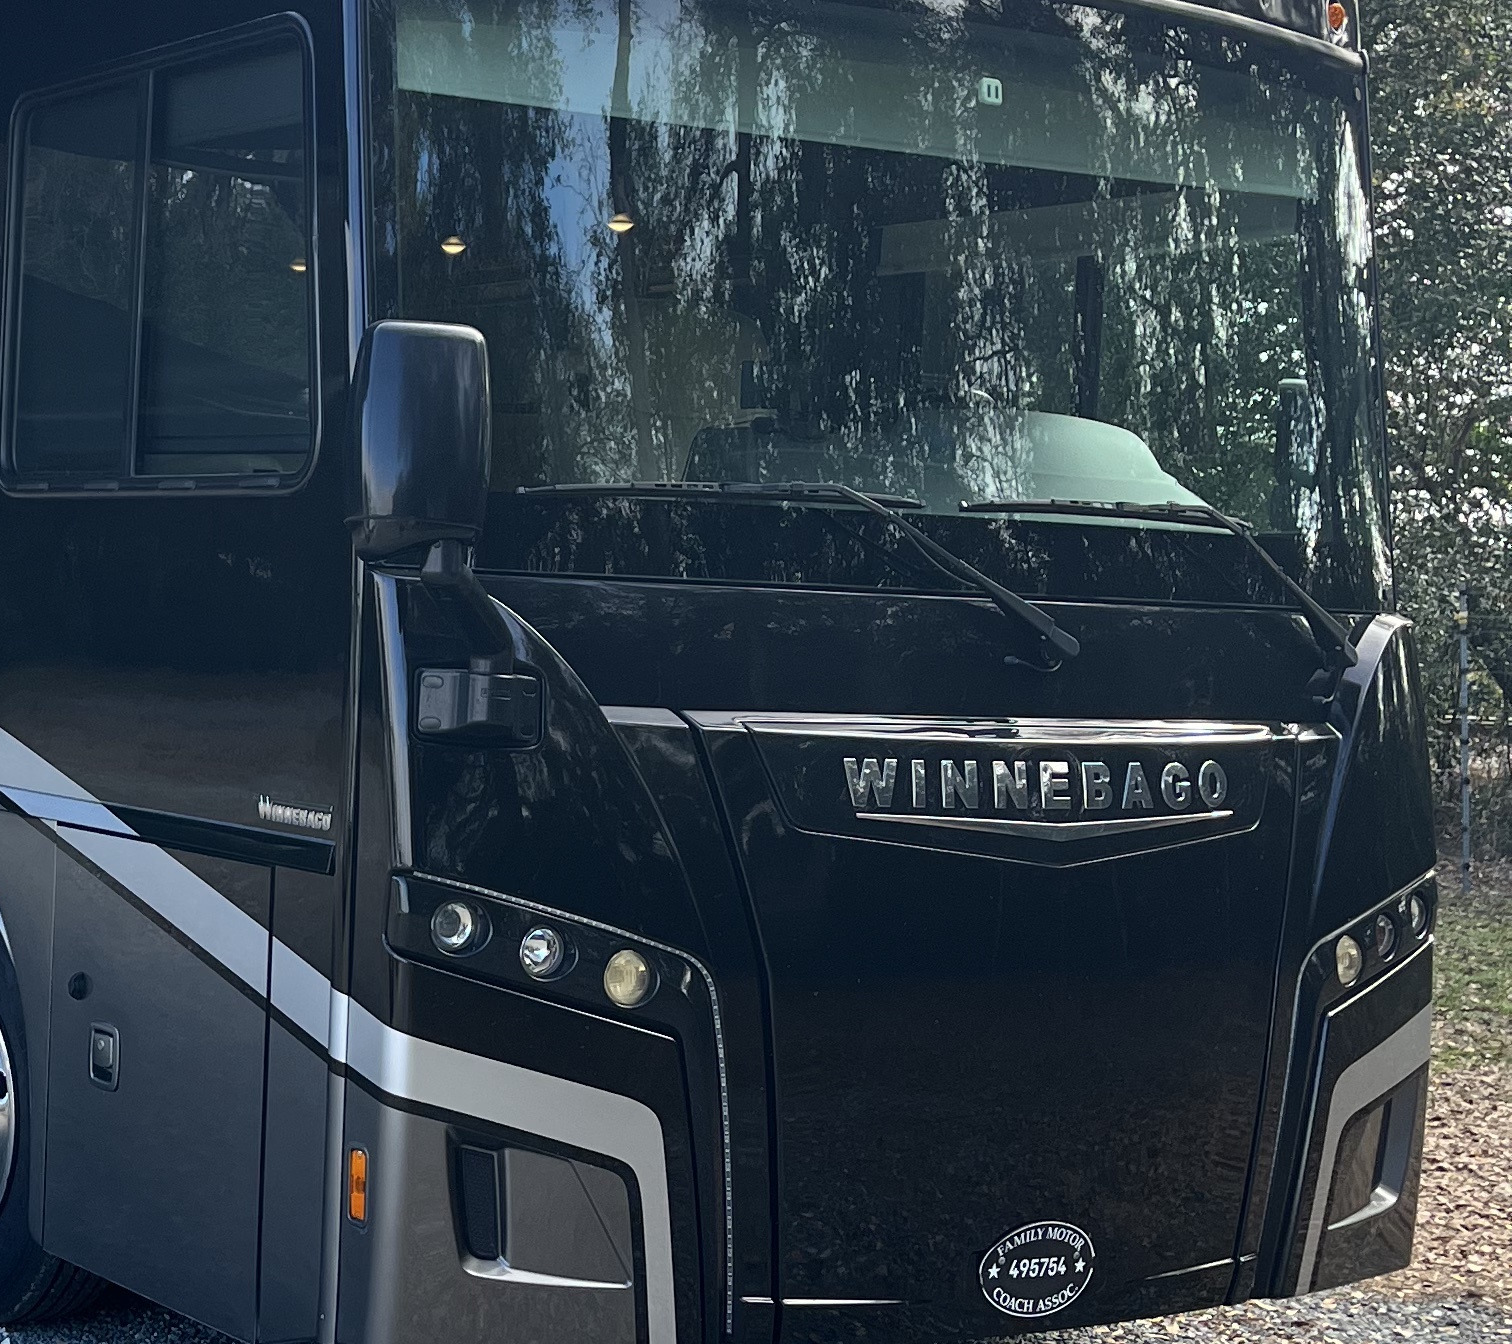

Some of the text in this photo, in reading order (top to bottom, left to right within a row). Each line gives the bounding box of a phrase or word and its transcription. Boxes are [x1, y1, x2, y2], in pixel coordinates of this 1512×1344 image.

[842, 757, 1229, 810] WINNEBAGO
[996, 1226, 1086, 1257] FAMILY MOTOR
[1008, 1256, 1067, 1279] 495754
[993, 1282, 1079, 1313] COACH ASSOC.
